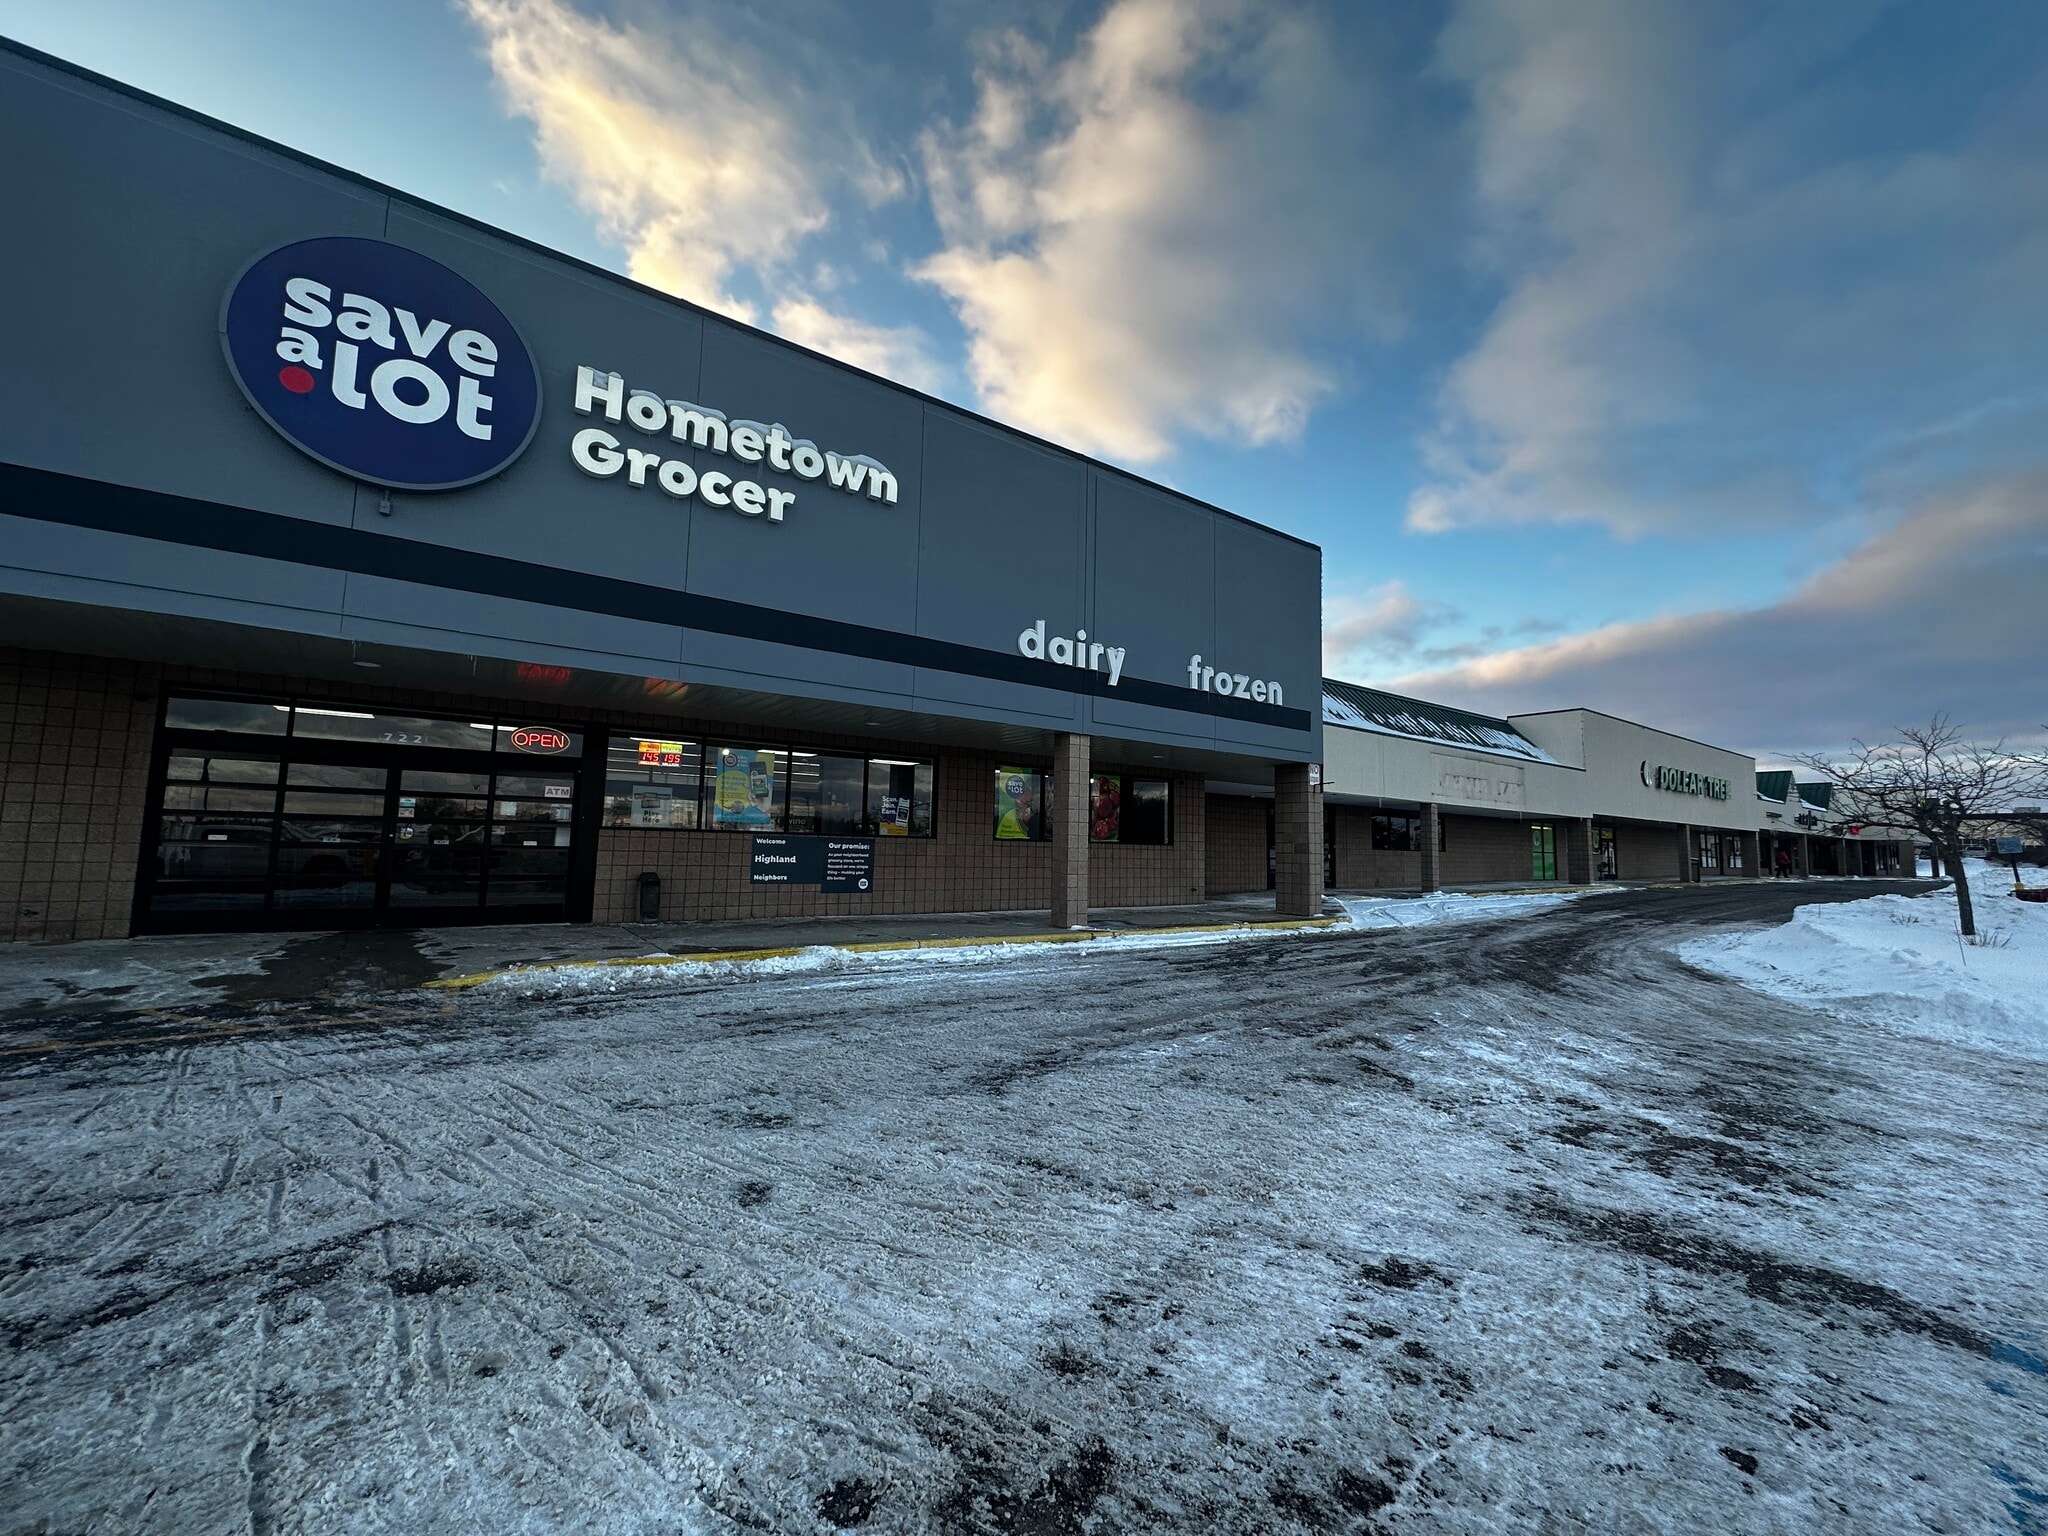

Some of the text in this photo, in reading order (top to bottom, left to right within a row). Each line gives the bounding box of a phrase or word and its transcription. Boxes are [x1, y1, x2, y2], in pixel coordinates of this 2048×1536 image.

[282, 276, 498, 377] save
[275, 326, 323, 369] a
[573, 364, 899, 504] Hometown
[571, 427, 796, 523] Grocer
[1017, 619, 1126, 687] dairy
[1187, 654, 1283, 706] frozen
[513, 732, 565, 748] OPEN
[642, 752, 659, 762] 145
[664, 753, 681, 763] 195
[545, 787, 570, 797] ATM
[1658, 765, 1732, 801] DOLLAR TREE
[841, 842, 870, 850] promise:
[754, 854, 797, 865] Highland
[753, 873, 788, 881] Neighbors
